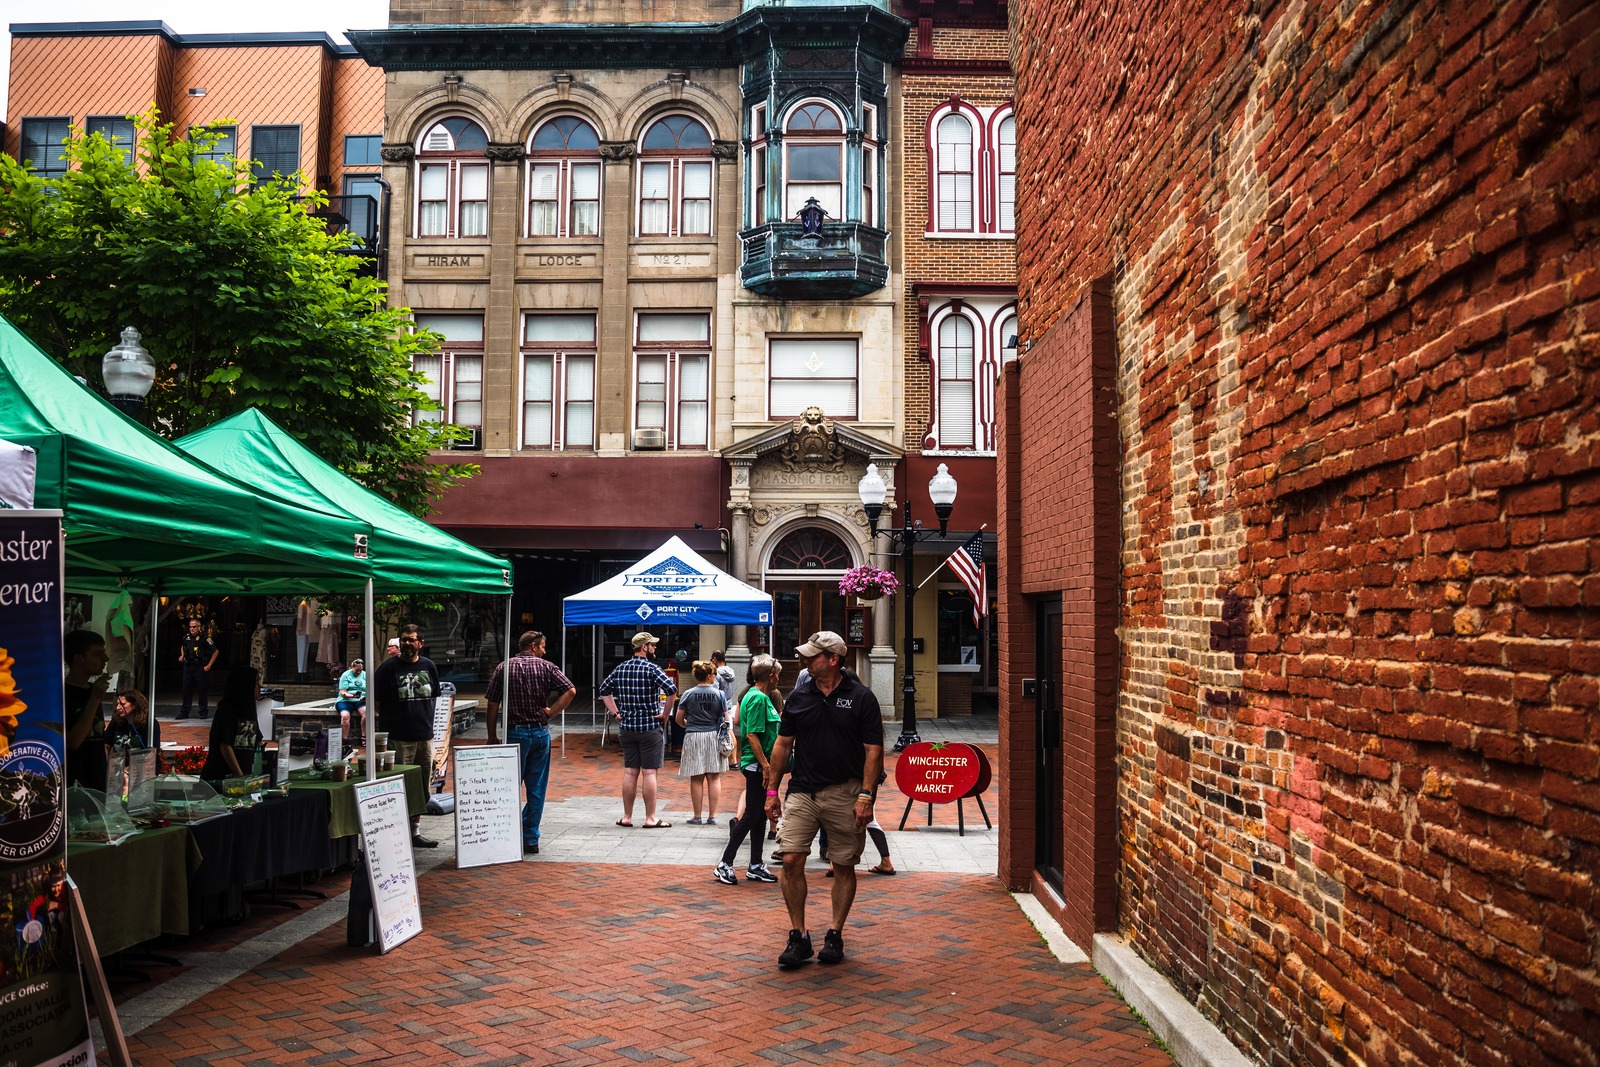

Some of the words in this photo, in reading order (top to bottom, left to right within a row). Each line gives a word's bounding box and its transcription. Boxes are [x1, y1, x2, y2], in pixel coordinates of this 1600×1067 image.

[428, 255, 471, 267] HIRAM
[538, 255, 582, 266] LODGE
[761, 472, 816, 484] MASONIC
[694, 693, 716, 702] THANK
[699, 702, 711, 711] YOU
[908, 756, 968, 767] WINCHESTER
[925, 770, 947, 780] CITY
[915, 784, 953, 794] MARKET
[19, 810, 62, 856] GARDENERS
[18, 981, 49, 998] Office:
